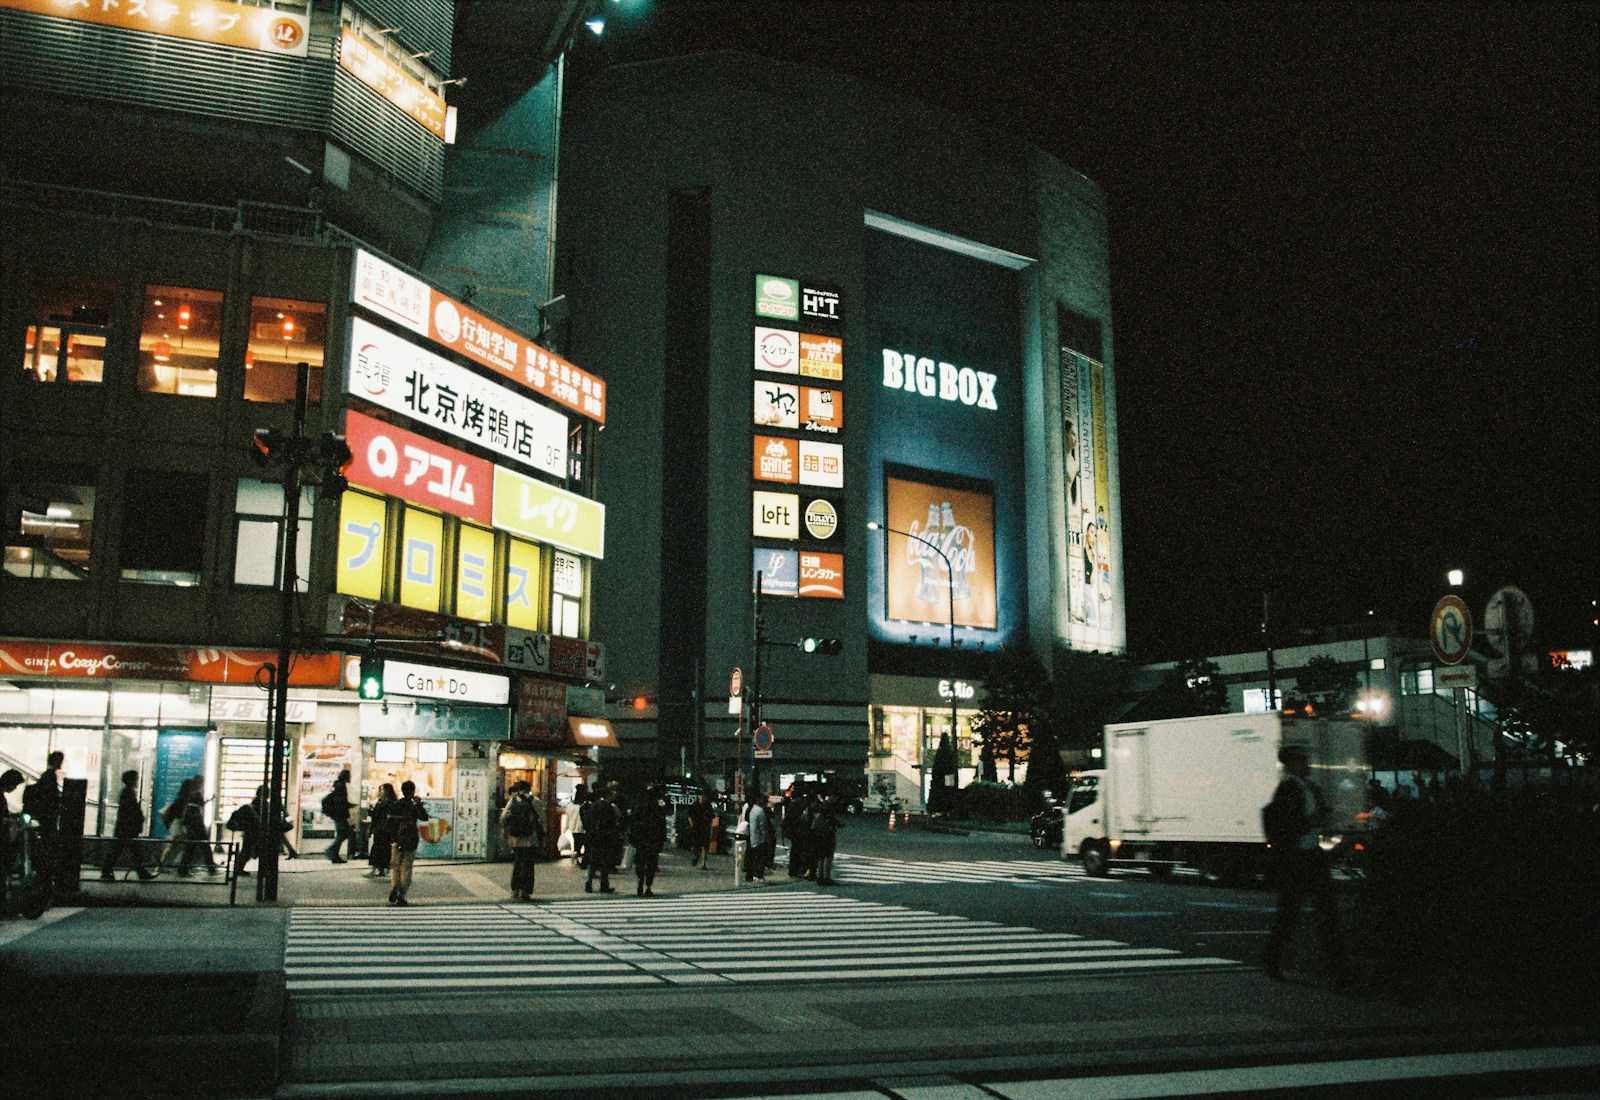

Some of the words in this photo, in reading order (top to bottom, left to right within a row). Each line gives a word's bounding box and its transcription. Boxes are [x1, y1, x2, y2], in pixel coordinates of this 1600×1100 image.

[760, 344, 795, 355] スシロー
[404, 370, 534, 460] 北京烤鴨店
[545, 445, 562, 469] 3F
[761, 456, 792, 474] GAME
[404, 445, 475, 506] アコム
[520, 484, 579, 534] レイク
[346, 521, 531, 609] プロミス
[555, 557, 575, 577] 銀行
[802, 567, 841, 580] レンタカー
[24, 657, 57, 667] GINZA
[59, 651, 104, 675] Cozy
[103, 654, 151, 671] Corner
[406, 673, 434, 691] Can
[449, 679, 468, 695] Do
[211, 701, 304, 720] 名店ル
